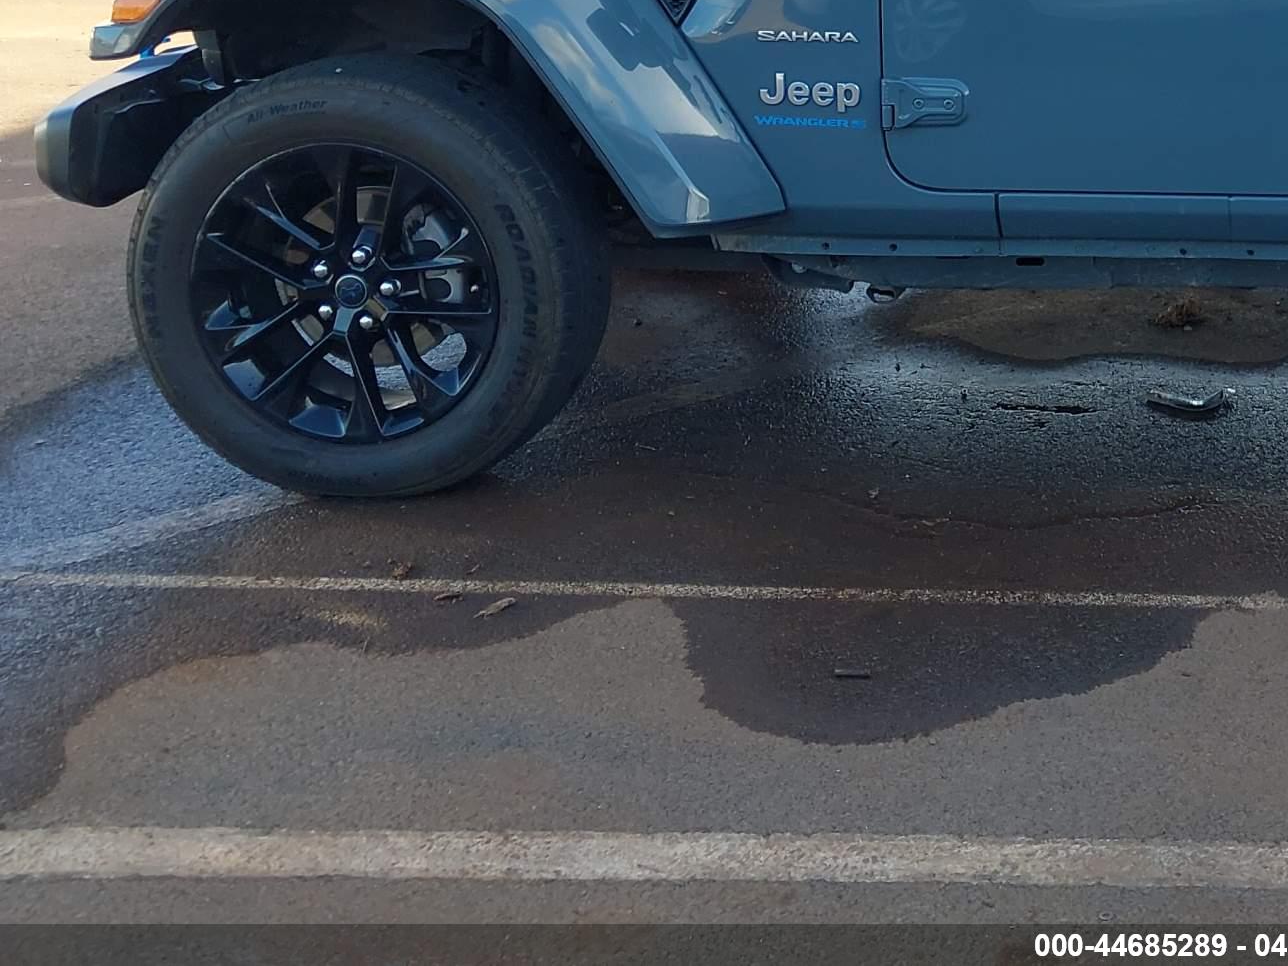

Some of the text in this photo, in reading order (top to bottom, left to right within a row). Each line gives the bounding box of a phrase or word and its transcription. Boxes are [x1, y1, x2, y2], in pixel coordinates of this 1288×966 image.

[757, 30, 860, 43] SAHARA
[760, 73, 860, 113] Jeep
[754, 115, 849, 128] WRANGLER
